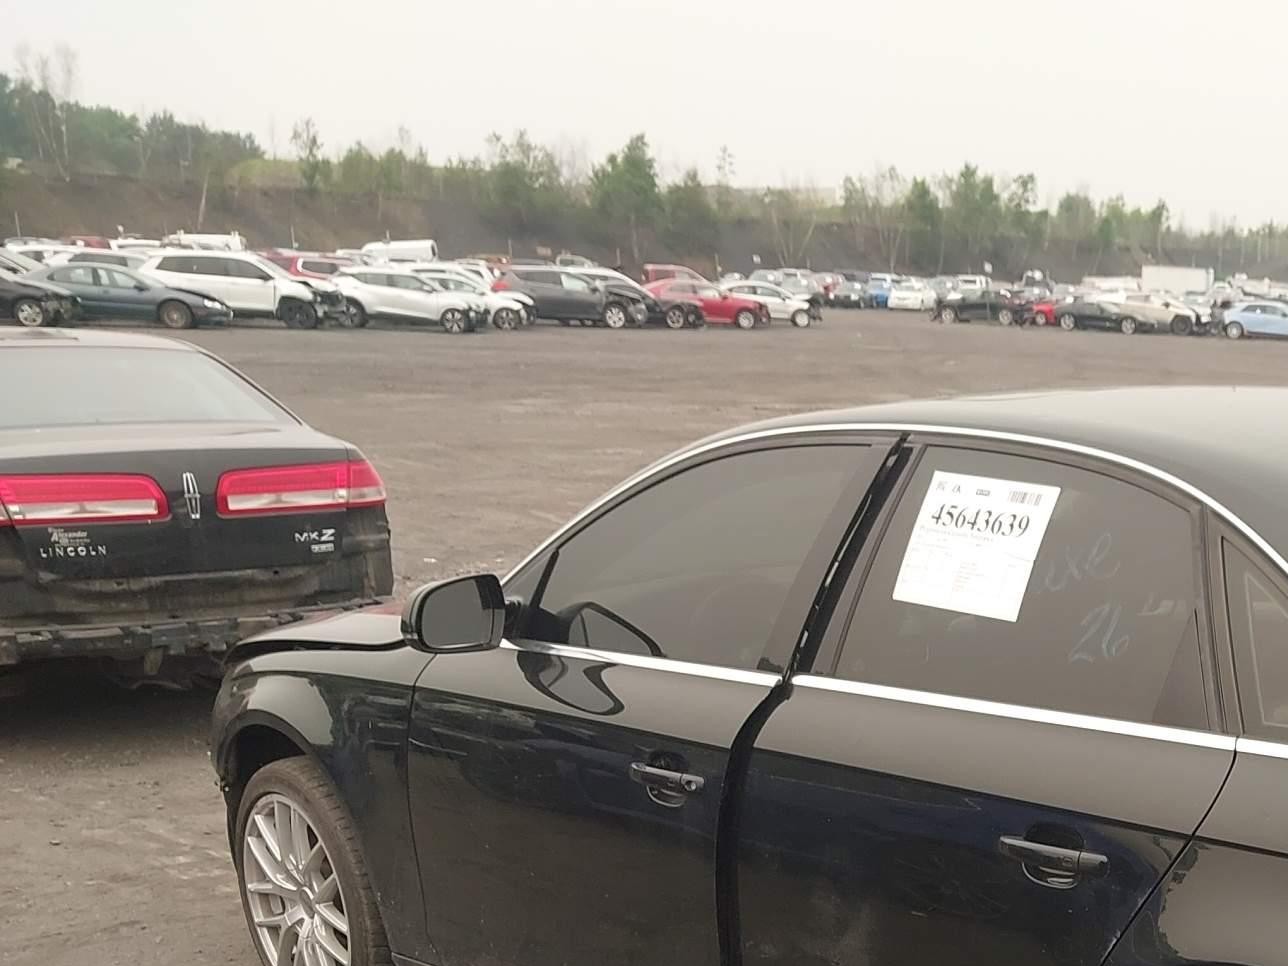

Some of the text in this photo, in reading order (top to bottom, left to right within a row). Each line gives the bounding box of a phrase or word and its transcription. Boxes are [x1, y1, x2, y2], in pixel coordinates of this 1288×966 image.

[931, 504, 1031, 538] 45643639
[294, 528, 336, 542] MKZ
[39, 545, 107, 559] LINCOLN
